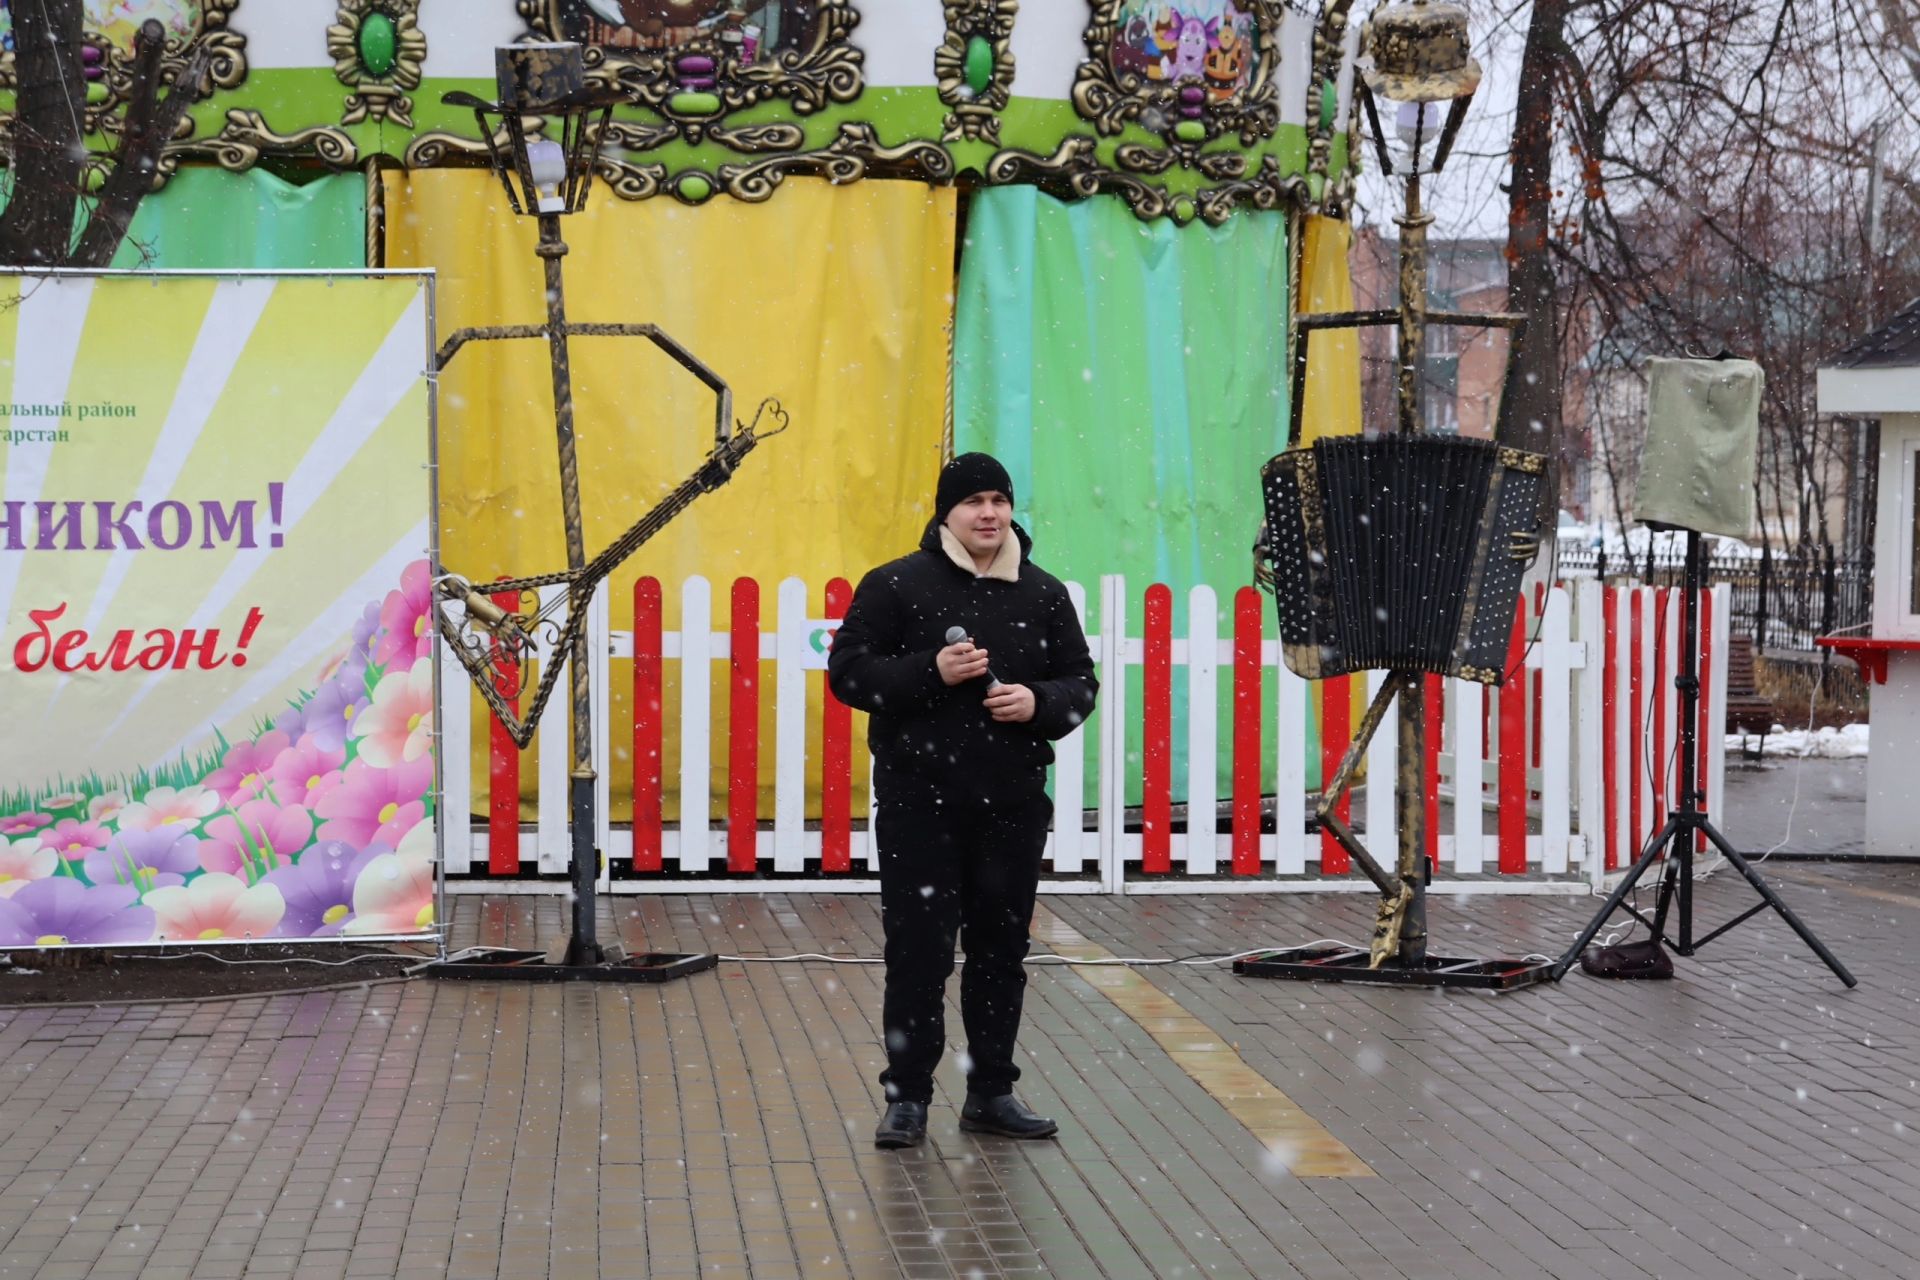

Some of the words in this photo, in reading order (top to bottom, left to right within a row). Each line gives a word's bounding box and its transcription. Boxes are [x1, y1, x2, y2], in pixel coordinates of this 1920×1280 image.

[78, 402, 136, 421] район
[0, 429, 69, 445] арстан
[13, 602, 264, 673] белән!
